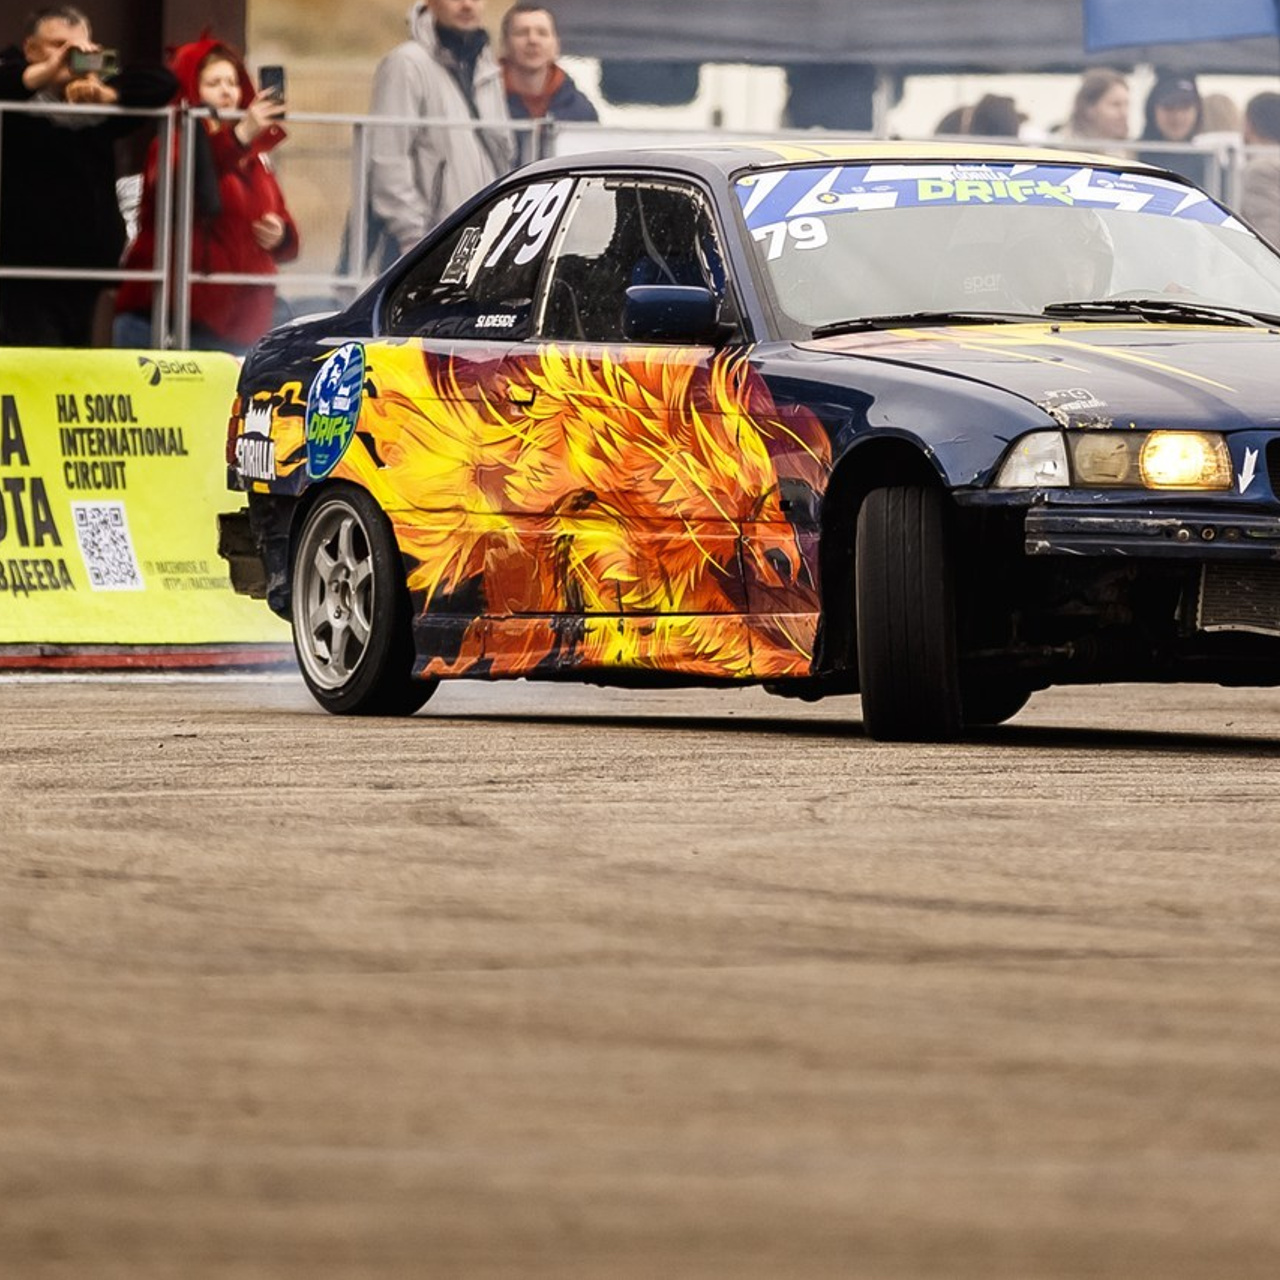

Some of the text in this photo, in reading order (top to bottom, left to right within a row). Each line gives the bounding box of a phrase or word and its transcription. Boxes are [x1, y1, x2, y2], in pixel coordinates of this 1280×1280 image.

[918, 178, 1074, 206] DRIFT
[483, 178, 575, 268] 79
[751, 216, 829, 262] 79
[963, 273, 1001, 294] spar
[84, 394, 138, 424] SOKOL
[0, 394, 30, 467] А
[59, 427, 189, 457] INTERNATIONAL
[63, 460, 127, 490] CIRCUIT
[0, 477, 63, 548] ТА
[0, 558, 76, 598] ВДЕЕВА
